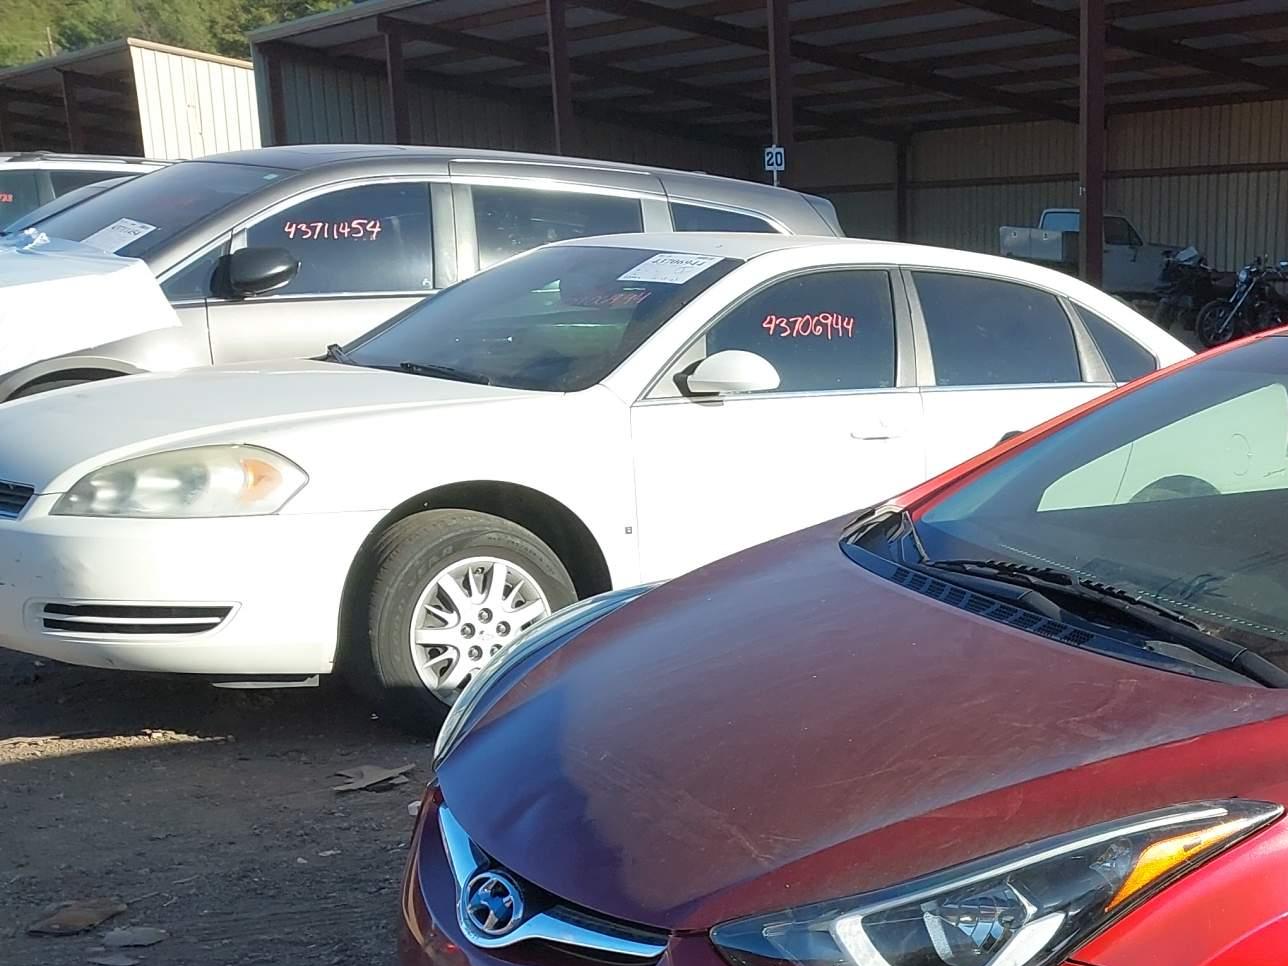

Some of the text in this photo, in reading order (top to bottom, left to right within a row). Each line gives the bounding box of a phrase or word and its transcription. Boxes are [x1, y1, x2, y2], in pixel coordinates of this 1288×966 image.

[766, 151, 783, 166] 20
[284, 219, 381, 241] 43711454
[762, 313, 854, 340] 43706944
